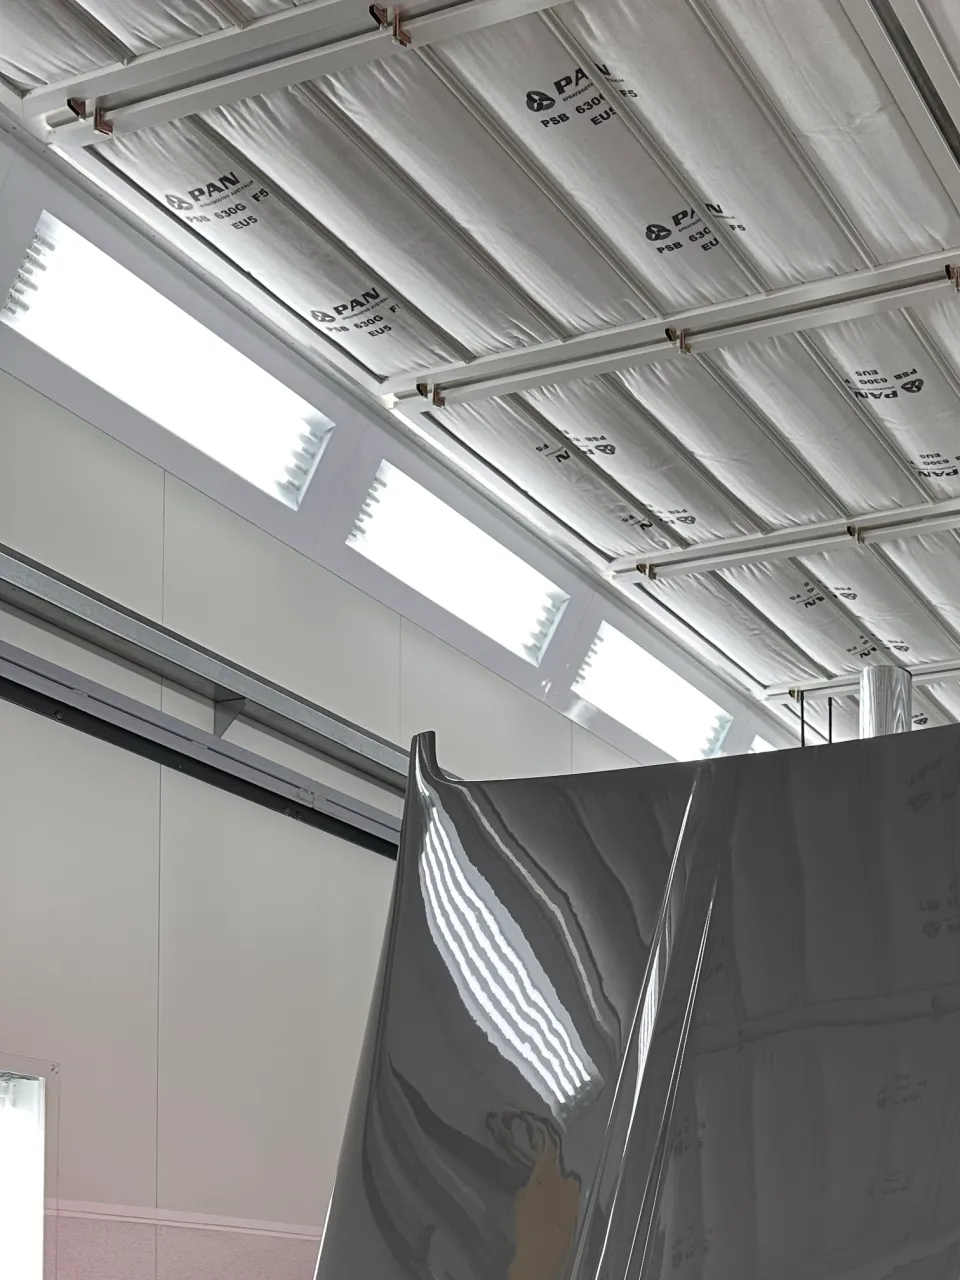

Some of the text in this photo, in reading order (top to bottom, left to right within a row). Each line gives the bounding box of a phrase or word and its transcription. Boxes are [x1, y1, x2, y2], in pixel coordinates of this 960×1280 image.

[540, 113, 570, 127] PSB
[619, 89, 638, 98] F5
[187, 171, 240, 202] PAN
[214, 203, 247, 219] 630G
[252, 188, 269, 202] F5
[231, 215, 258, 230] EU5
[656, 242, 684, 253] PSB
[333, 287, 380, 316] PAN
[354, 314, 384, 329] 630G
[367, 324, 392, 337] EU5
[854, 390, 899, 399] PAN
[917, 468, 959, 477] PAN
